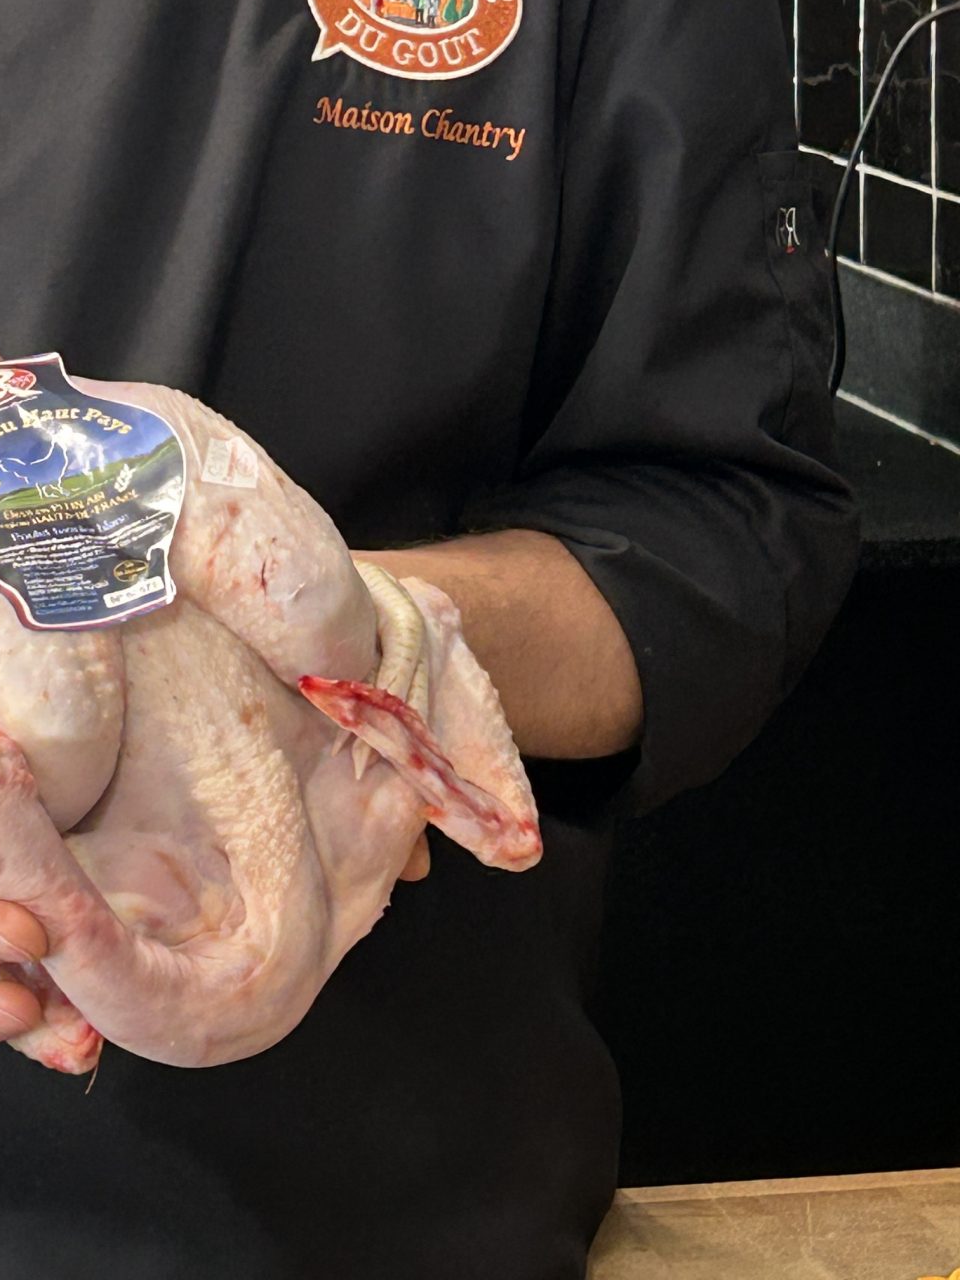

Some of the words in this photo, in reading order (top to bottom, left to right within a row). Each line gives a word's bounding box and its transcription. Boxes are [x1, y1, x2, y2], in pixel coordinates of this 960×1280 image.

[335, 8, 387, 52] DU
[392, 28, 483, 67] GOUT
[313, 96, 415, 135] Maison
[421, 108, 526, 161] Chantry
[82, 408, 134, 435] Pays
